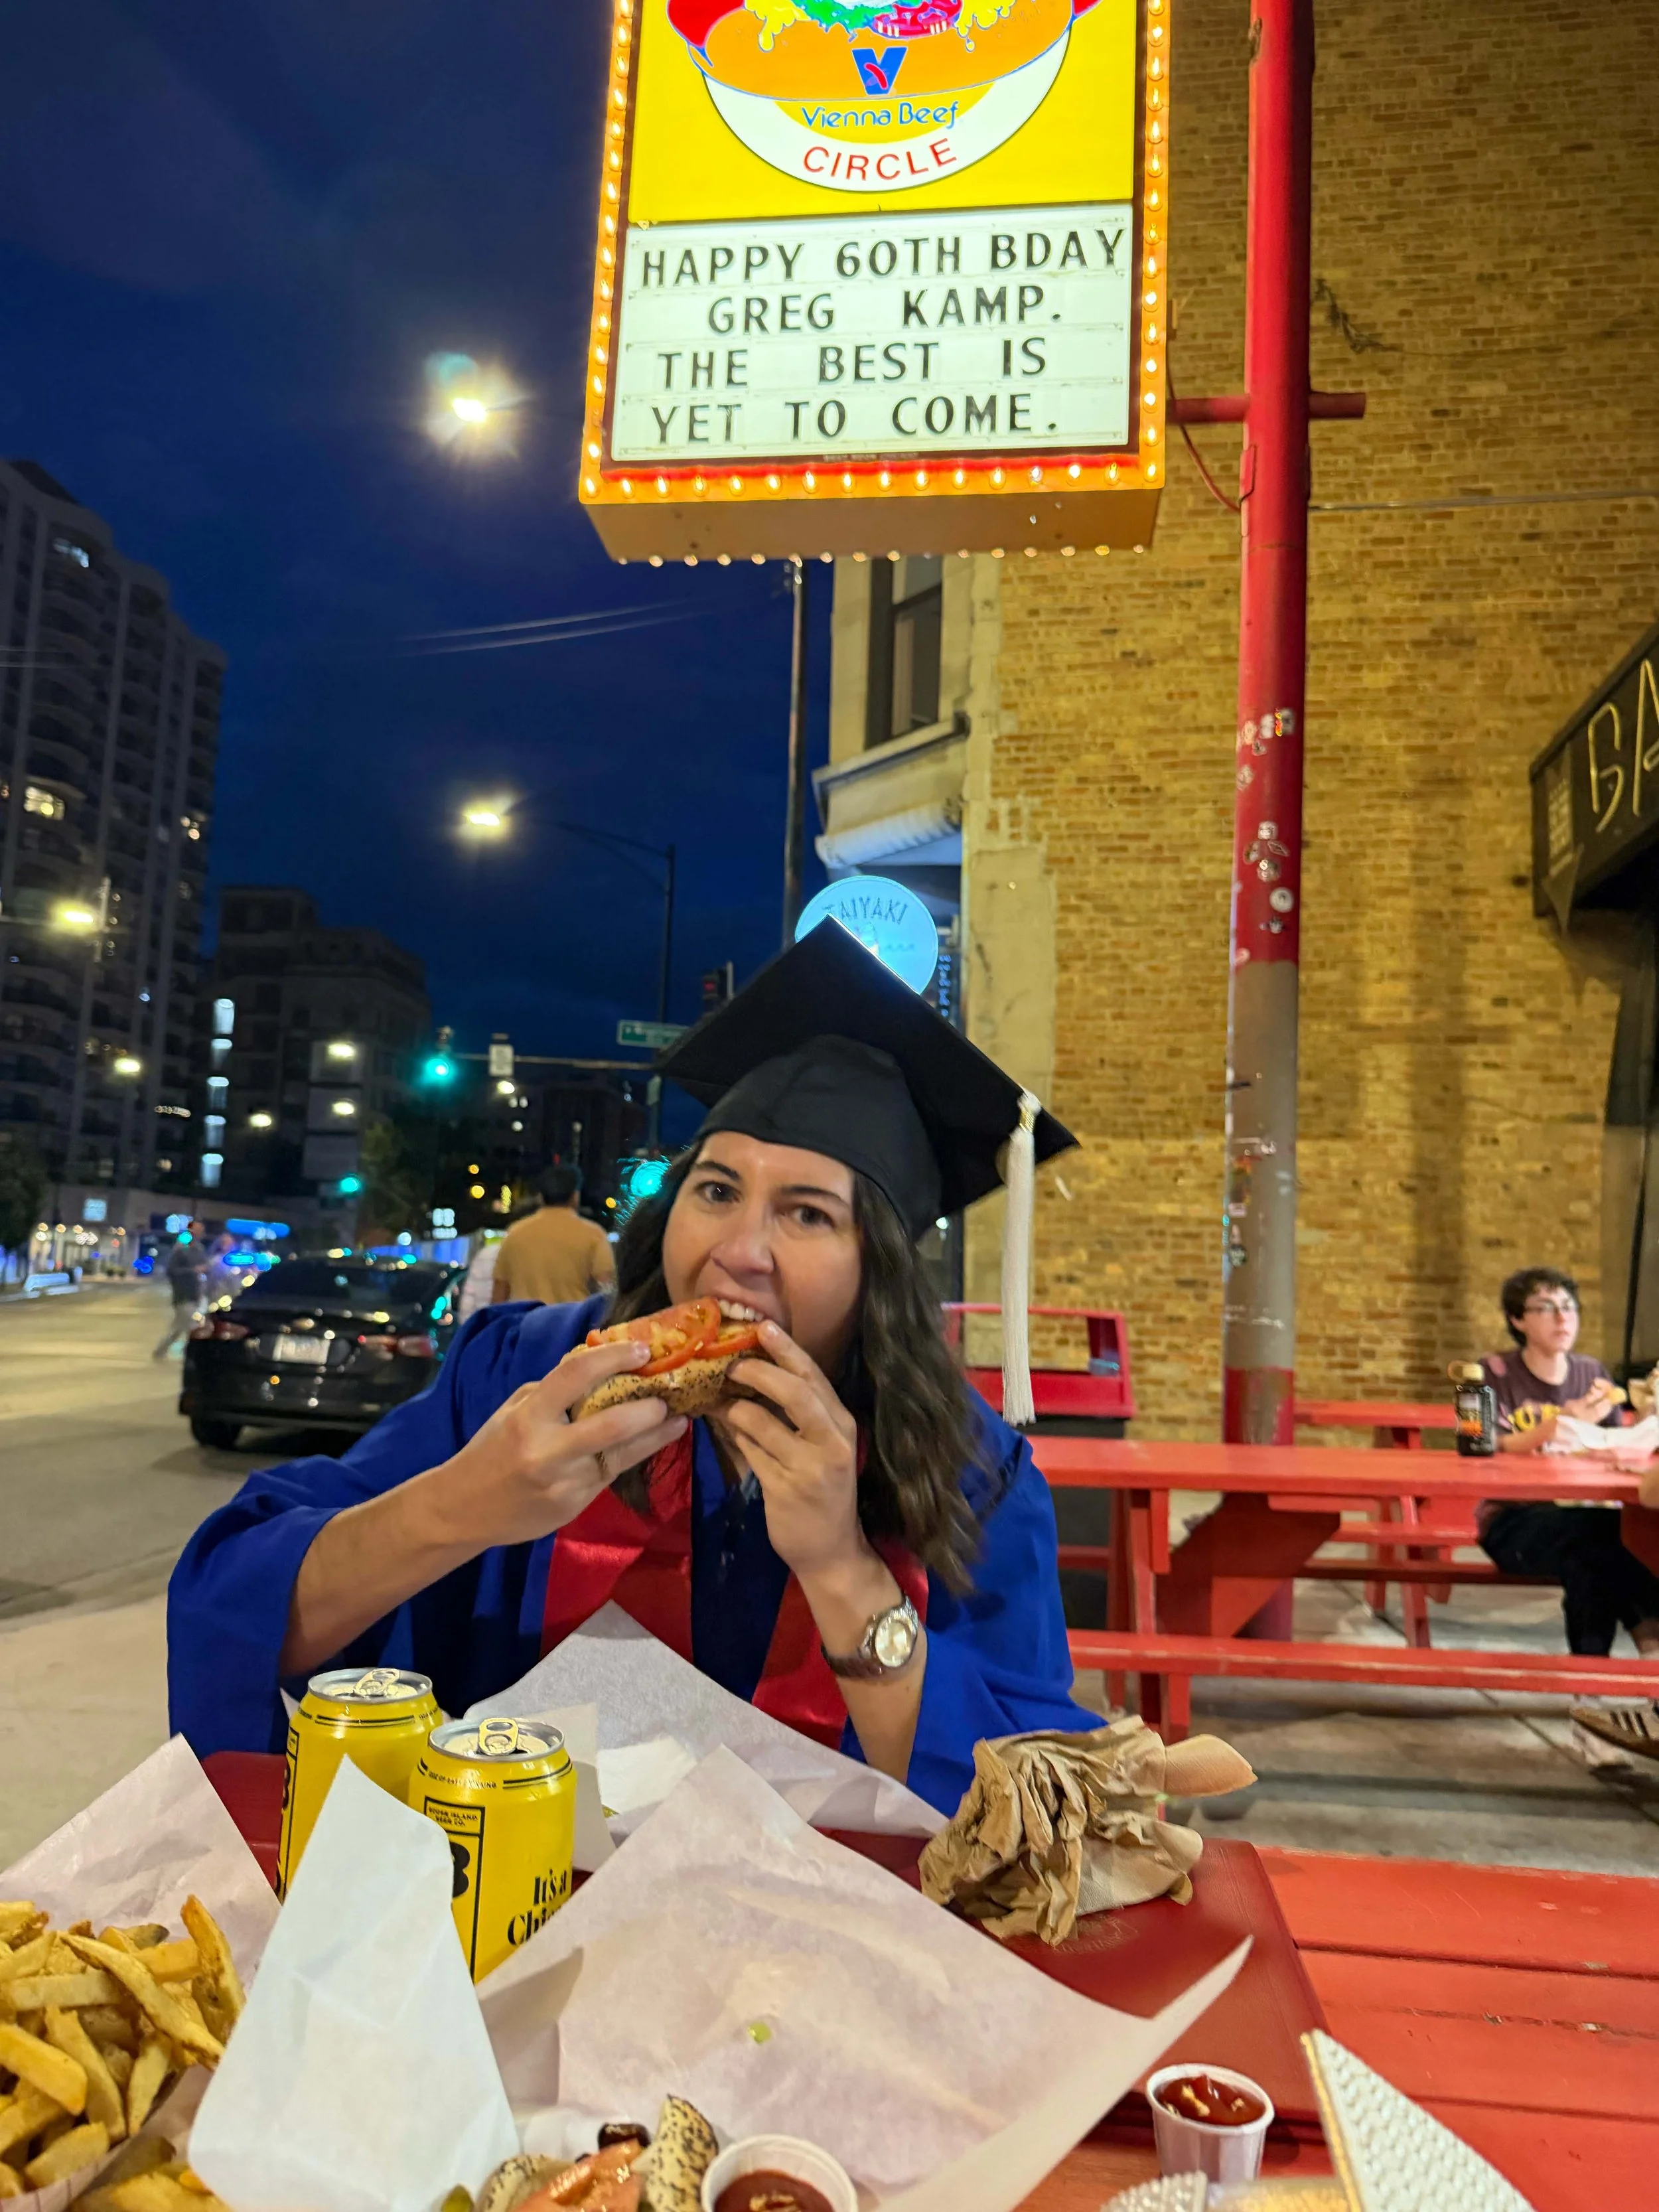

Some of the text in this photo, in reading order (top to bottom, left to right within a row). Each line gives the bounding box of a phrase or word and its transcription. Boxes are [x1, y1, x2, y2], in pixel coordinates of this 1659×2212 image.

[802, 101, 959, 129] Vienna Beef
[803, 137, 956, 181] CIRCLE
[642, 228, 1125, 288] HAPPY 60TH BDAY
[708, 285, 1060, 334] GREG KAMP.
[658, 336, 1046, 390] THE BEST IS
[652, 393, 1057, 443] YET TO COME.
